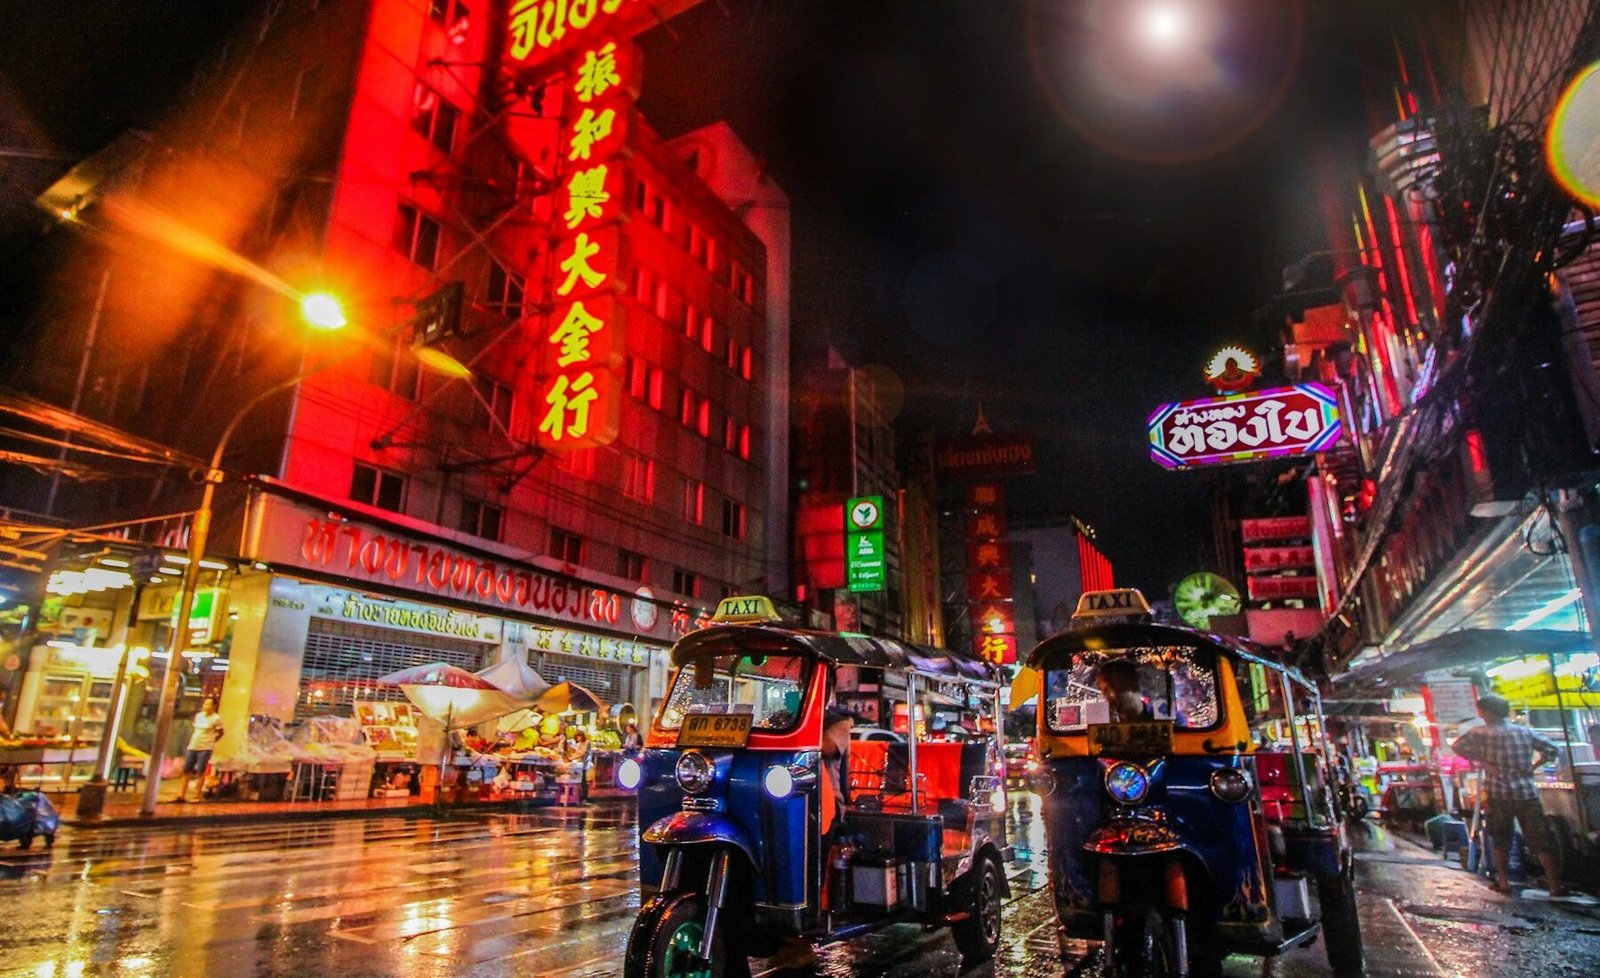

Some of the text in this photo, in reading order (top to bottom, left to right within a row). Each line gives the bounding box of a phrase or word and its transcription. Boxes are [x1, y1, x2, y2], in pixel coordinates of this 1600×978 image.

[1168, 400, 1320, 455] ทองใบ
[724, 600, 760, 615] TAXI
[1088, 593, 1133, 609] TAXI
[714, 717, 747, 731] 6738
